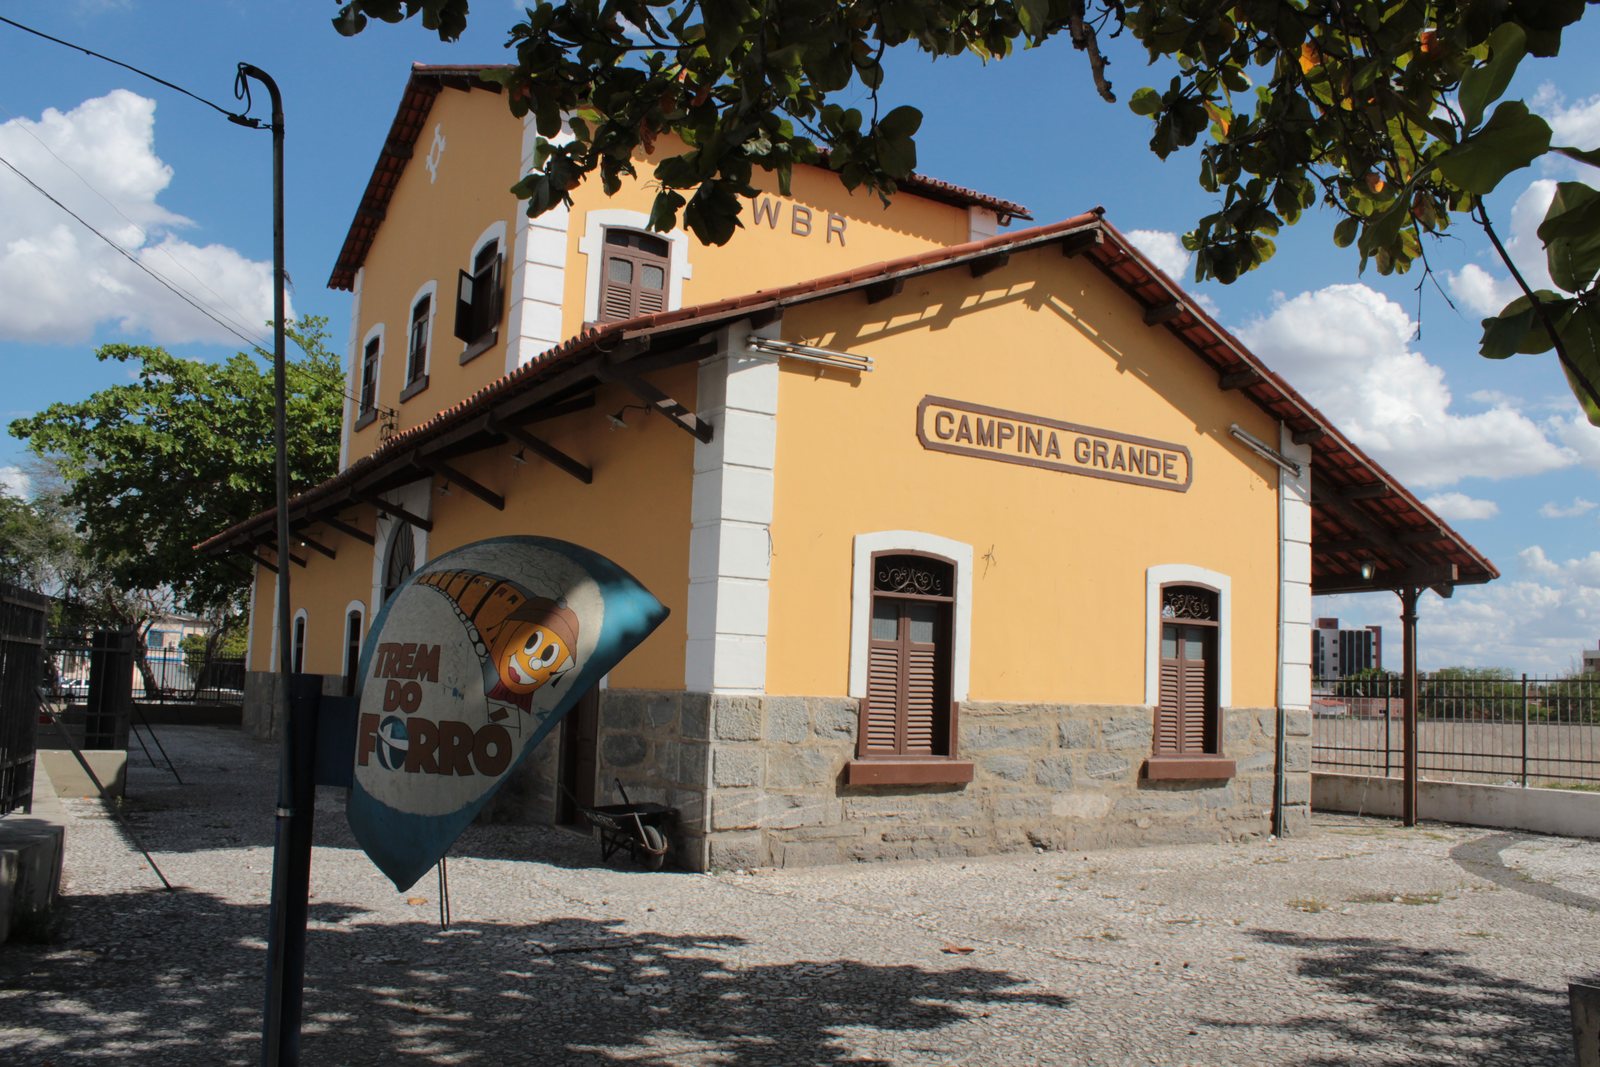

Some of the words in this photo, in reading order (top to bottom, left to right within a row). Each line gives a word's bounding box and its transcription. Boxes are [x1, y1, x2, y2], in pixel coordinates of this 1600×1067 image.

[935, 411, 1061, 459] CAMPINA
[1074, 437, 1178, 480] GRANDE
[373, 643, 441, 683] TREM
[383, 680, 423, 714] DO
[358, 707, 513, 777] FORRÓ
